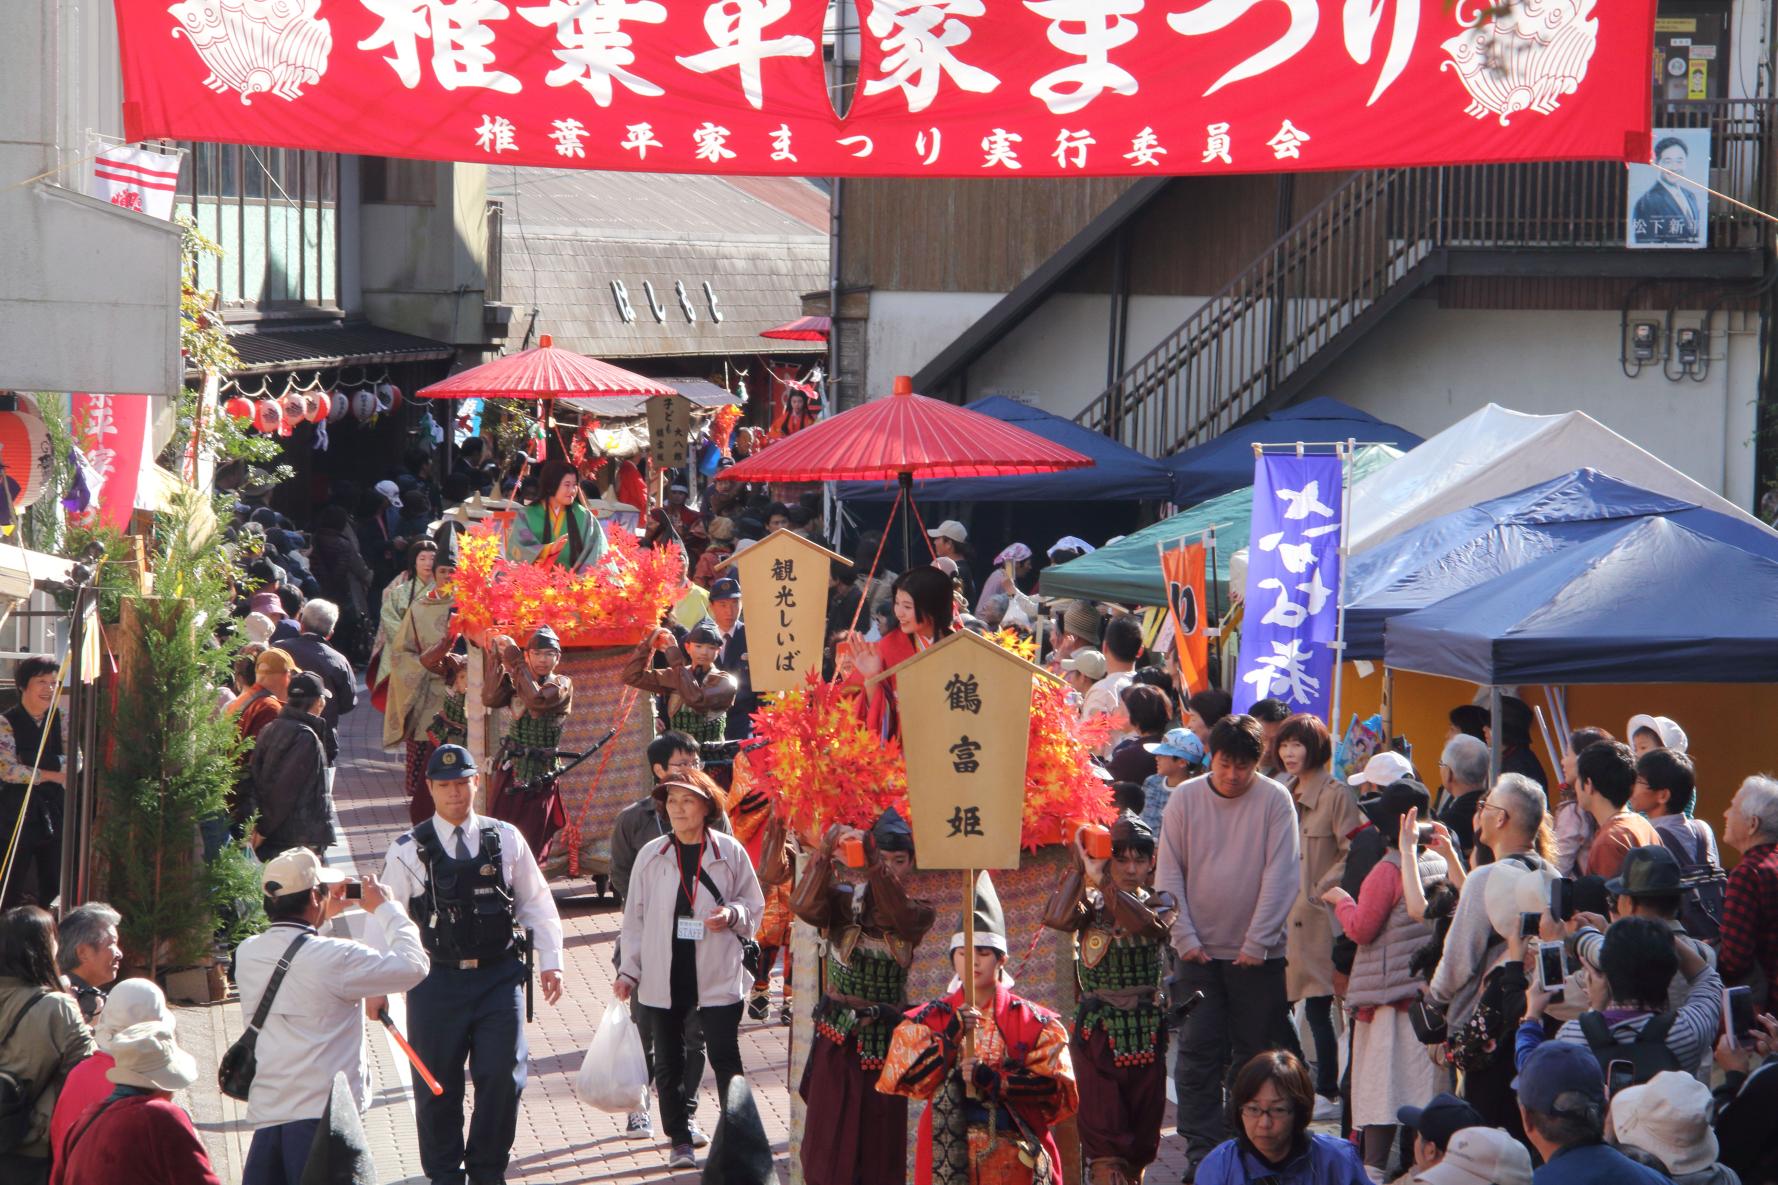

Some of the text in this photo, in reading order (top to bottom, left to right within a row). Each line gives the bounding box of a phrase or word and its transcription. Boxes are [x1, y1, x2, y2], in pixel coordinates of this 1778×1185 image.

[475, 113, 1311, 172] 椎葉平家まつり実行委員会
[609, 279, 724, 324] はしもと
[771, 559, 798, 673] 観光しいば
[945, 674, 984, 839] 鶴富姫
[678, 927, 702, 938] STAFF
